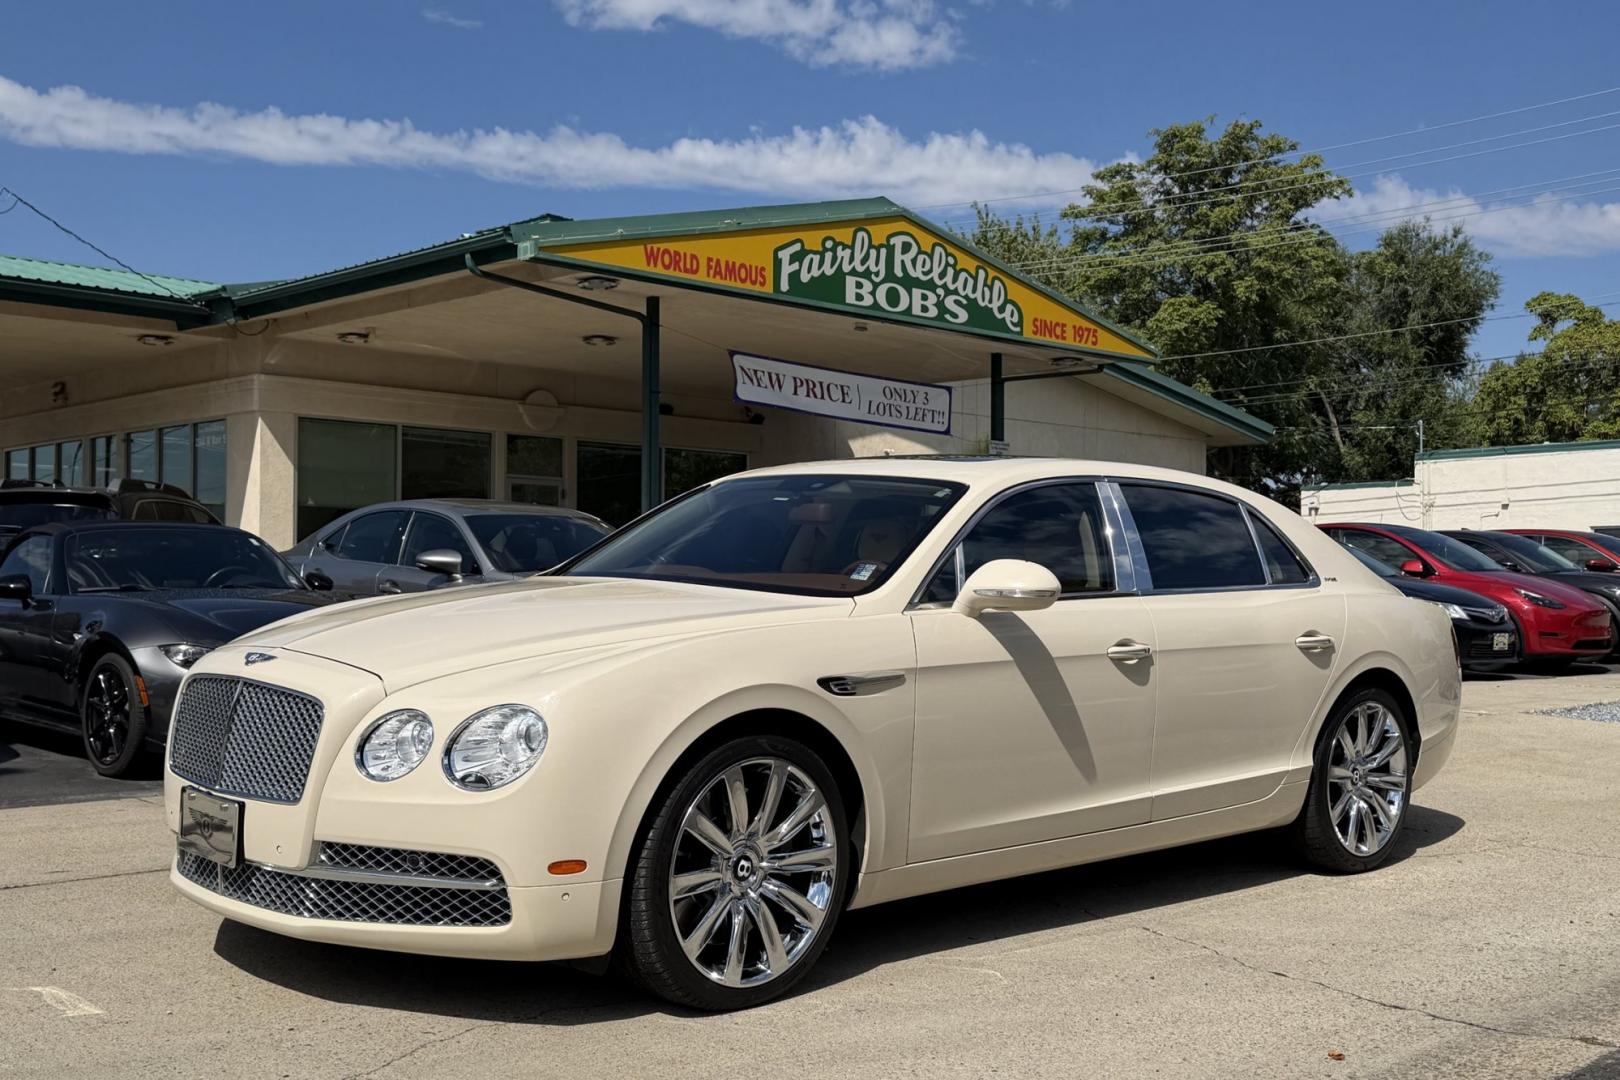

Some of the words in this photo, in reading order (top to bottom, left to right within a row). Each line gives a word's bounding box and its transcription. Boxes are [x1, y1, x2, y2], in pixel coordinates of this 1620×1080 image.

[643, 244, 700, 275] WORLD
[706, 256, 767, 288] FAMOUS
[777, 231, 887, 293] Fairly
[889, 234, 1021, 332] Reliable
[845, 275, 969, 324] BOB'S
[1032, 317, 1067, 341] SINCE
[1072, 324, 1099, 347] 1975
[739, 365, 786, 393] NEW
[792, 375, 853, 404] PRICE
[882, 385, 920, 406] ONLY
[923, 391, 929, 406] 3
[867, 400, 903, 418] LOTS
[905, 407, 945, 425] LEFT!!
